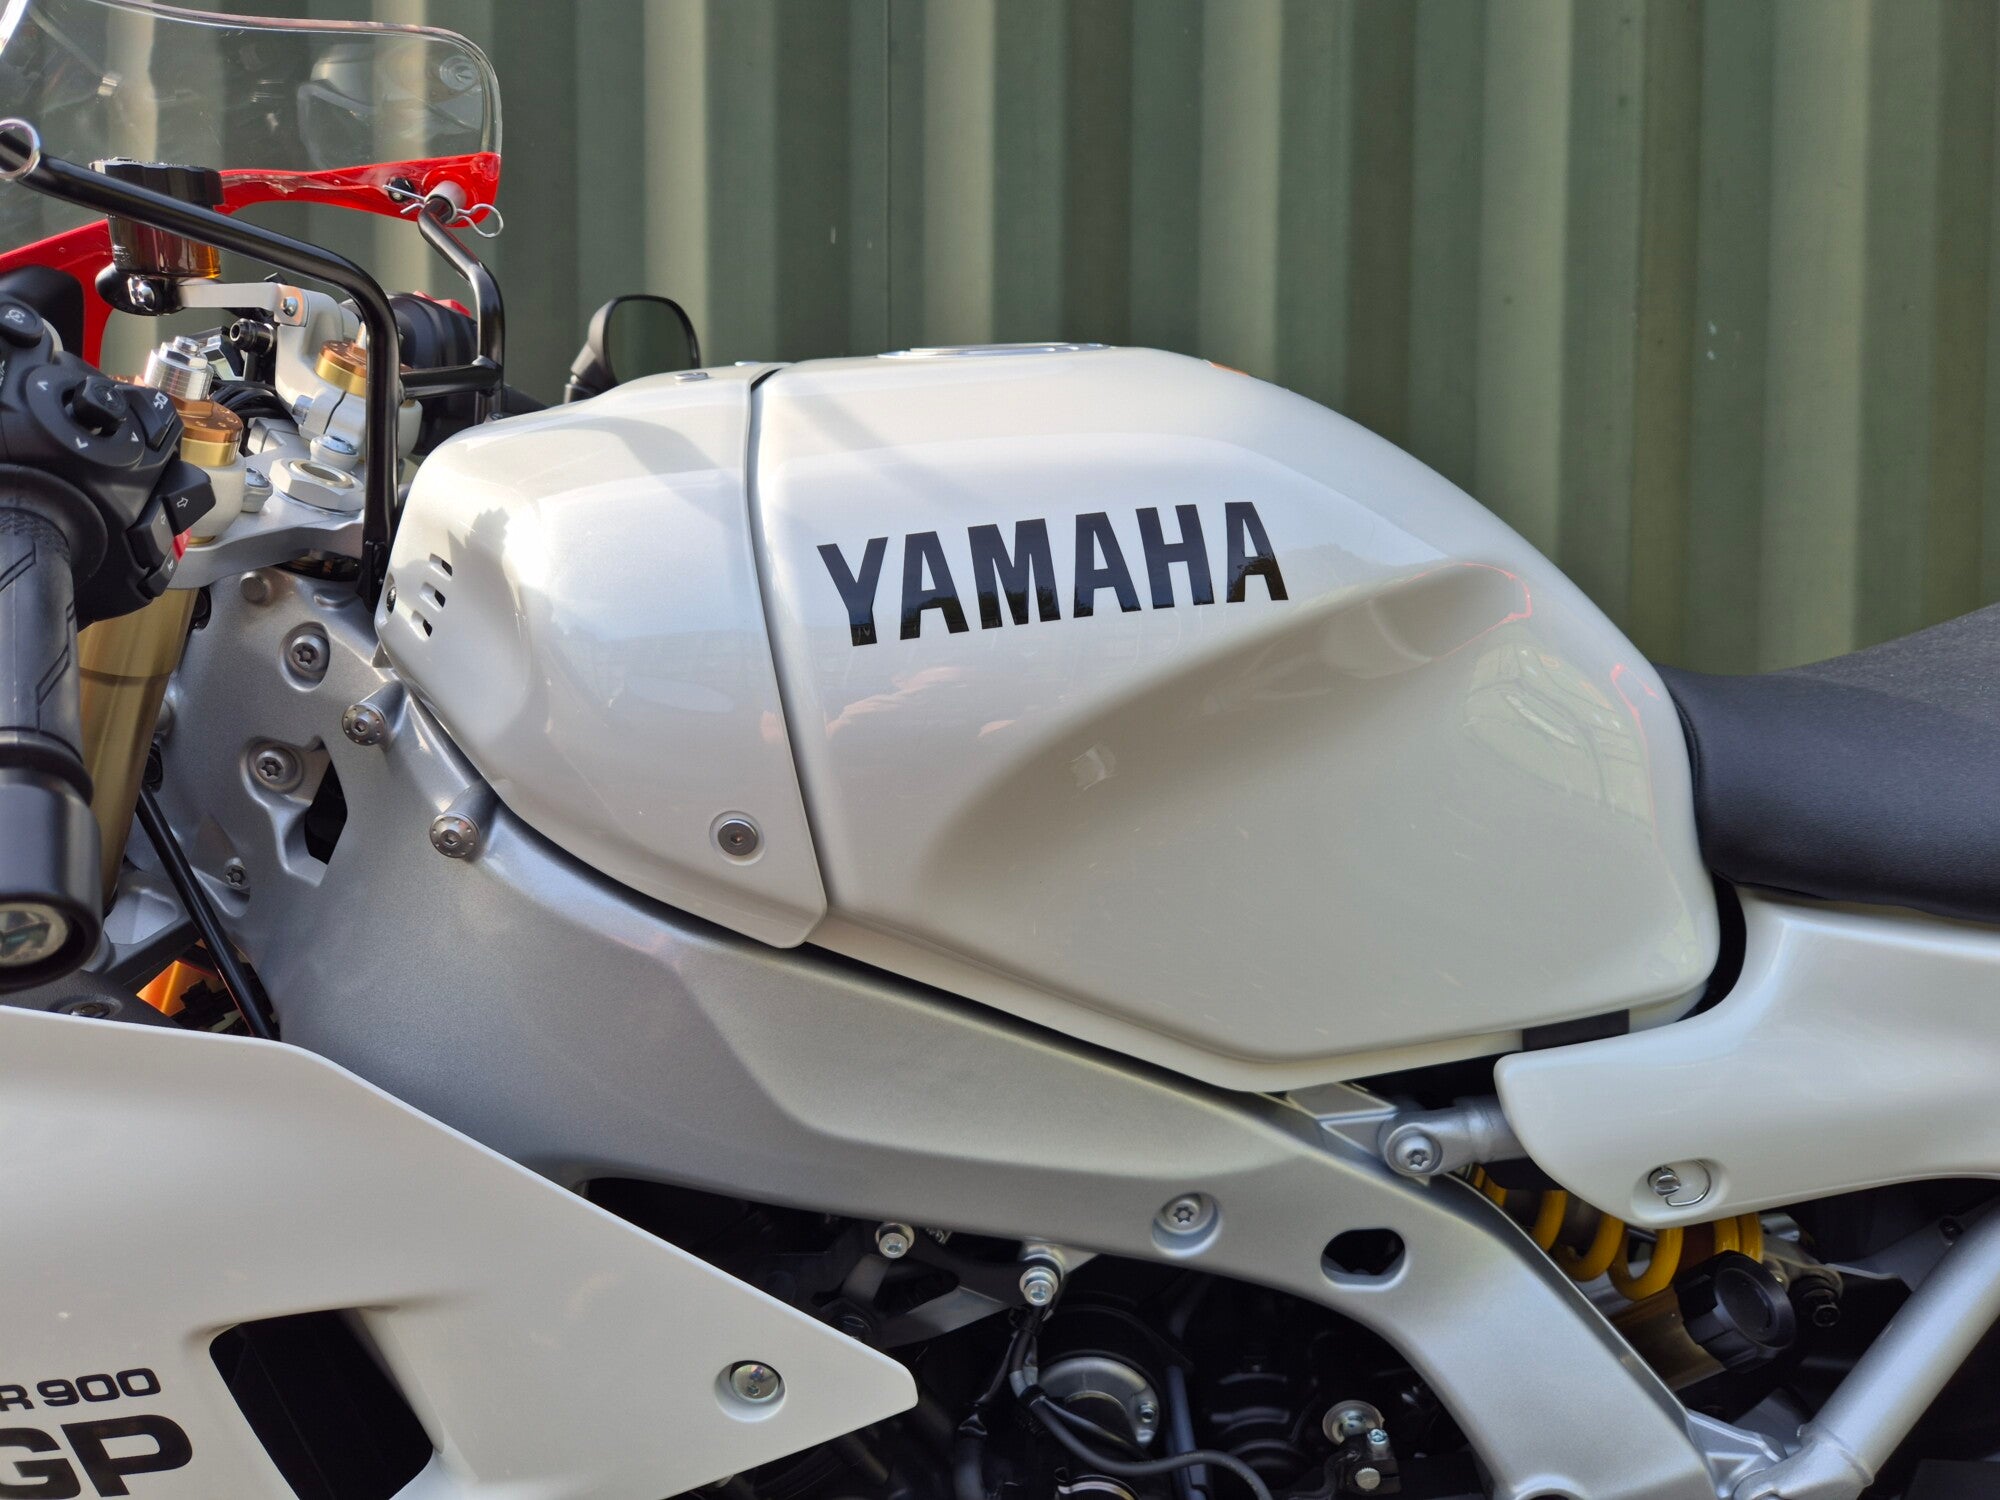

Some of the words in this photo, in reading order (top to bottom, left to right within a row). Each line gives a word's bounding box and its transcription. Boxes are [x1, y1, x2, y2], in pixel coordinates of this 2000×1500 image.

[816, 501, 1289, 647] YAMAHA
[37, 1368, 161, 1406] 900
[0, 1414, 193, 1500] GP
